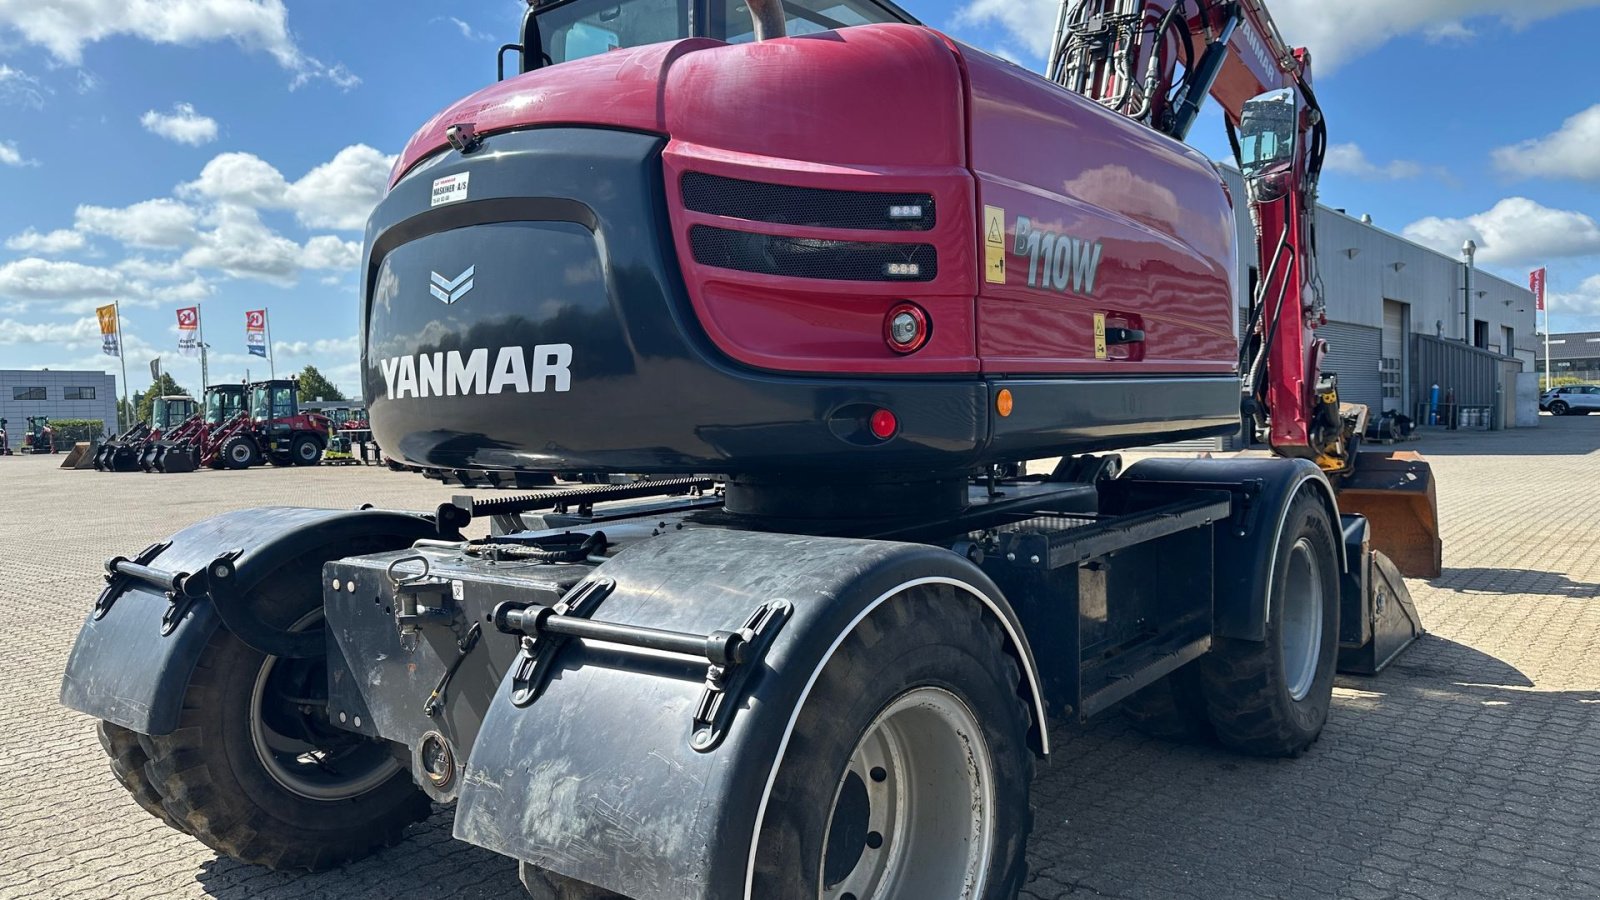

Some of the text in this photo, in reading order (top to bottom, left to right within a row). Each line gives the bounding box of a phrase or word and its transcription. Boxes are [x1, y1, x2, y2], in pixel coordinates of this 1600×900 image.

[433, 181, 467, 196] MASKINER A/S
[1014, 215, 1103, 295] B110W
[380, 343, 573, 400] YANMAR
